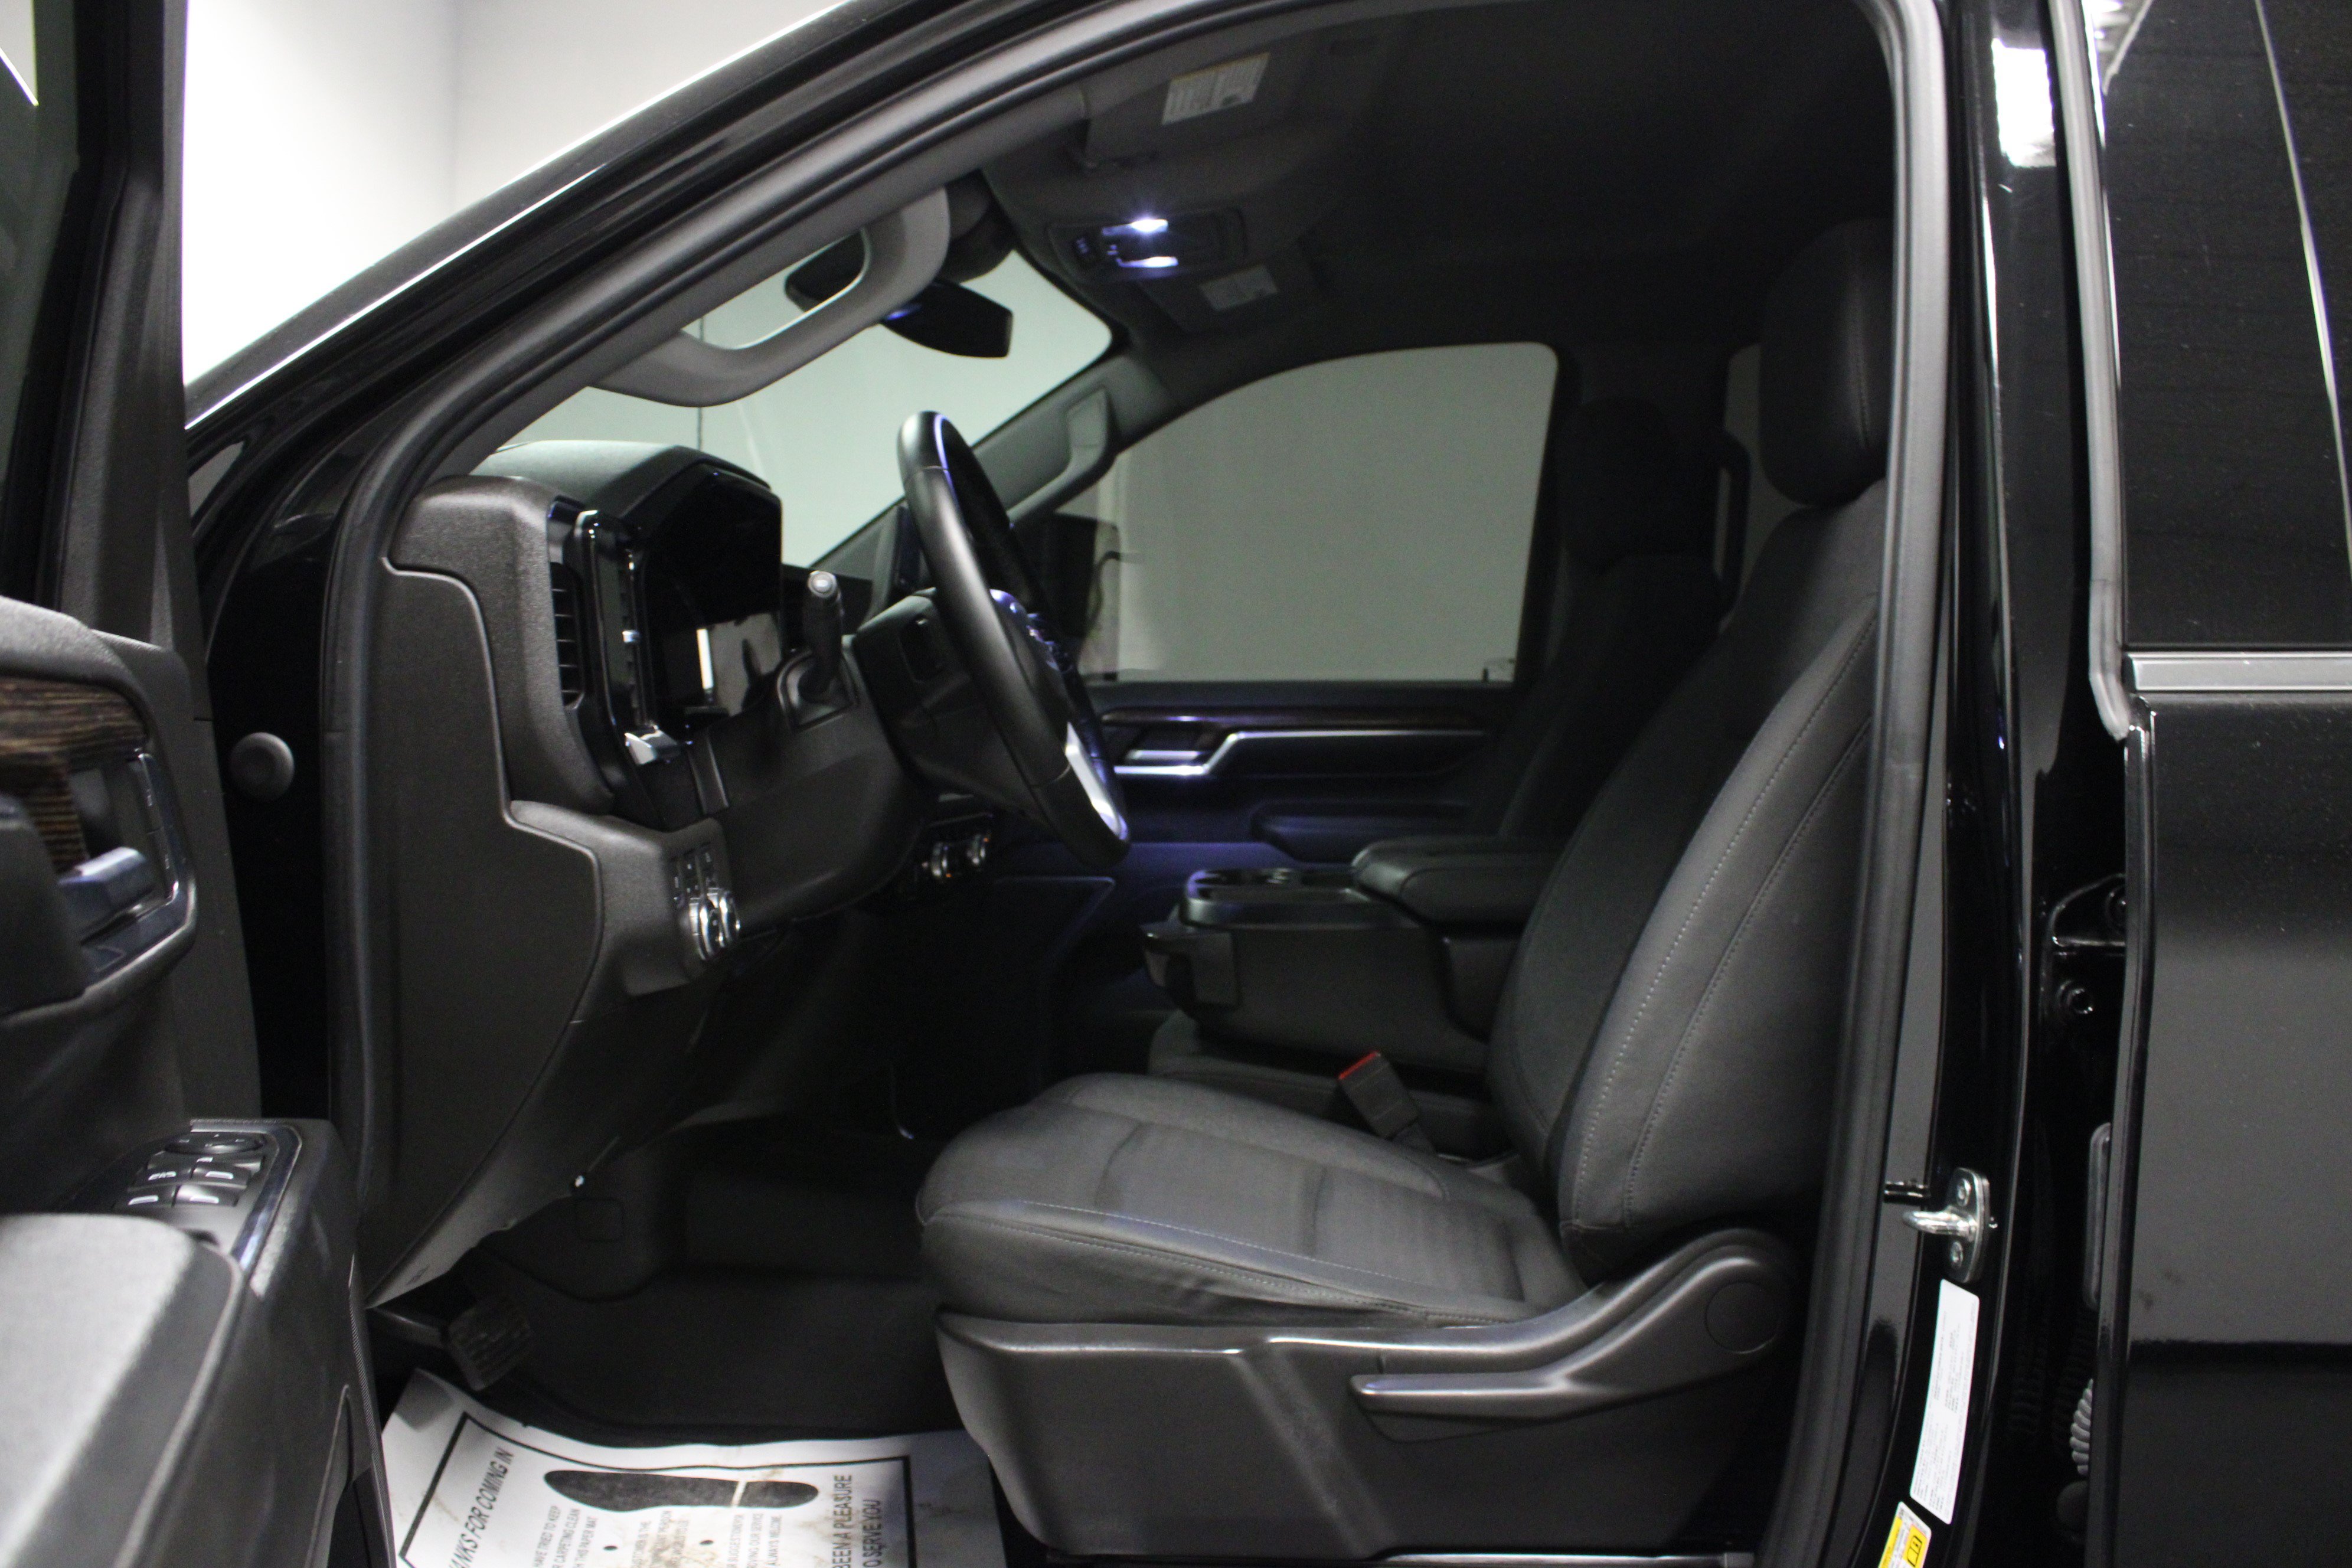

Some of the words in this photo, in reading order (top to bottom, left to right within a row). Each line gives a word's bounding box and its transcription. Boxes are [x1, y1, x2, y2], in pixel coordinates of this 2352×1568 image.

[494, 1446, 514, 1465] IN
[475, 1461, 508, 1511] COMING
[832, 1474, 852, 1529] PLEASURE
[547, 1505, 561, 1522] KEEP
[564, 1508, 580, 1529] CLEAN
[861, 1499, 881, 1524] YOU
[463, 1506, 490, 1540] FOR
[543, 1523, 556, 1531] TO
[584, 1516, 597, 1529] MAT
[750, 1513, 765, 1532] SERVICE
[537, 1532, 553, 1550] TRIED
[554, 1529, 575, 1564] CARPETING
[578, 1530, 594, 1548] PAPER
[748, 1533, 761, 1546] OUR
[861, 1524, 883, 1558] SERVE
[573, 1549, 589, 1563] THIS
[766, 1540, 780, 1566] ALWAYS
